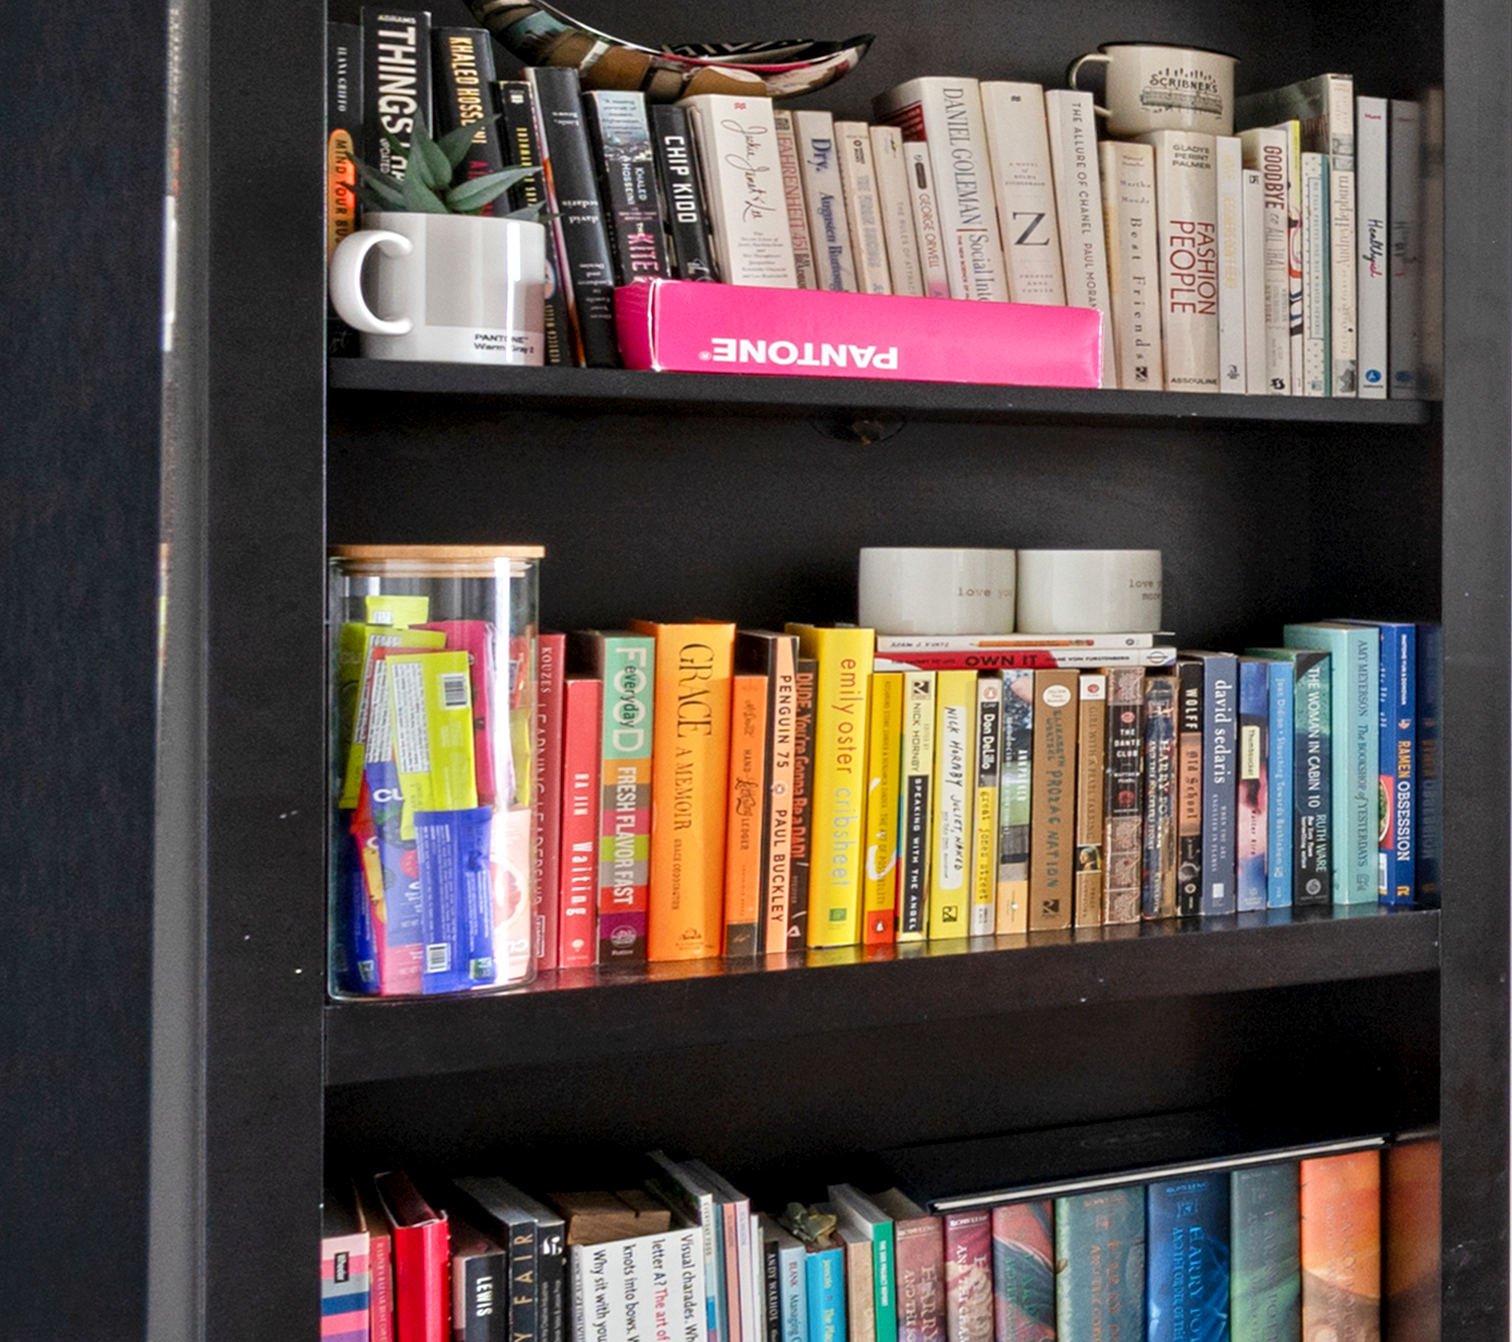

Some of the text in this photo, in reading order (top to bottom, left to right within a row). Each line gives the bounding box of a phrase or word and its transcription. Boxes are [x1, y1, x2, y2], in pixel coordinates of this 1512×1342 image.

[378, 27, 418, 134] THINGS
[449, 36, 480, 85] KHALED
[1149, 73, 1219, 94] SCRIBNER'S
[664, 135, 698, 224] CHIP KIDD
[807, 138, 832, 174] Dry.
[943, 88, 982, 226] DANIEL GOLEMAN
[1263, 145, 1285, 210] GOODBYE
[818, 192, 836, 244] Augusten
[919, 193, 941, 268] GEORGE ORWELL
[1012, 211, 1051, 247] Z
[1129, 217, 1151, 360] Best Friends
[1169, 220, 1197, 314] PEOPLE
[1196, 221, 1217, 316] FASHION
[711, 337, 898, 370] PANTONE
[540, 646, 552, 693] KOUZES
[612, 647, 648, 753] FOOD
[619, 664, 640, 728] everyday
[676, 643, 715, 739] GRACE
[776, 674, 793, 769] PENGUIN 75
[1184, 688, 1199, 729] WOLFF
[1213, 679, 1233, 785] david sedaris
[1306, 667, 1321, 808] THE WOMAN IN CABIN 10
[673, 746, 694, 831] A MEMOIR
[831, 658, 864, 886] emily oster cribsheet
[1396, 740, 1412, 861] RAMEN OBSESSION
[613, 766, 638, 906] FRESH FLAVOR FAST
[769, 809, 788, 923] PAUL BUCKLEY
[1315, 814, 1327, 873] RUTH WARE
[566, 841, 593, 917] Waiting
[514, 1232, 534, 1305] FAIR
[652, 1239, 666, 1269] letter
[653, 1272, 667, 1286] A?
[681, 1234, 696, 1268] Visual
[476, 1276, 493, 1318] LEWIS
[655, 1288, 669, 1309] The
[656, 1311, 669, 1328] art
[683, 1271, 698, 1324] charades.
[657, 1330, 671, 1341] of
